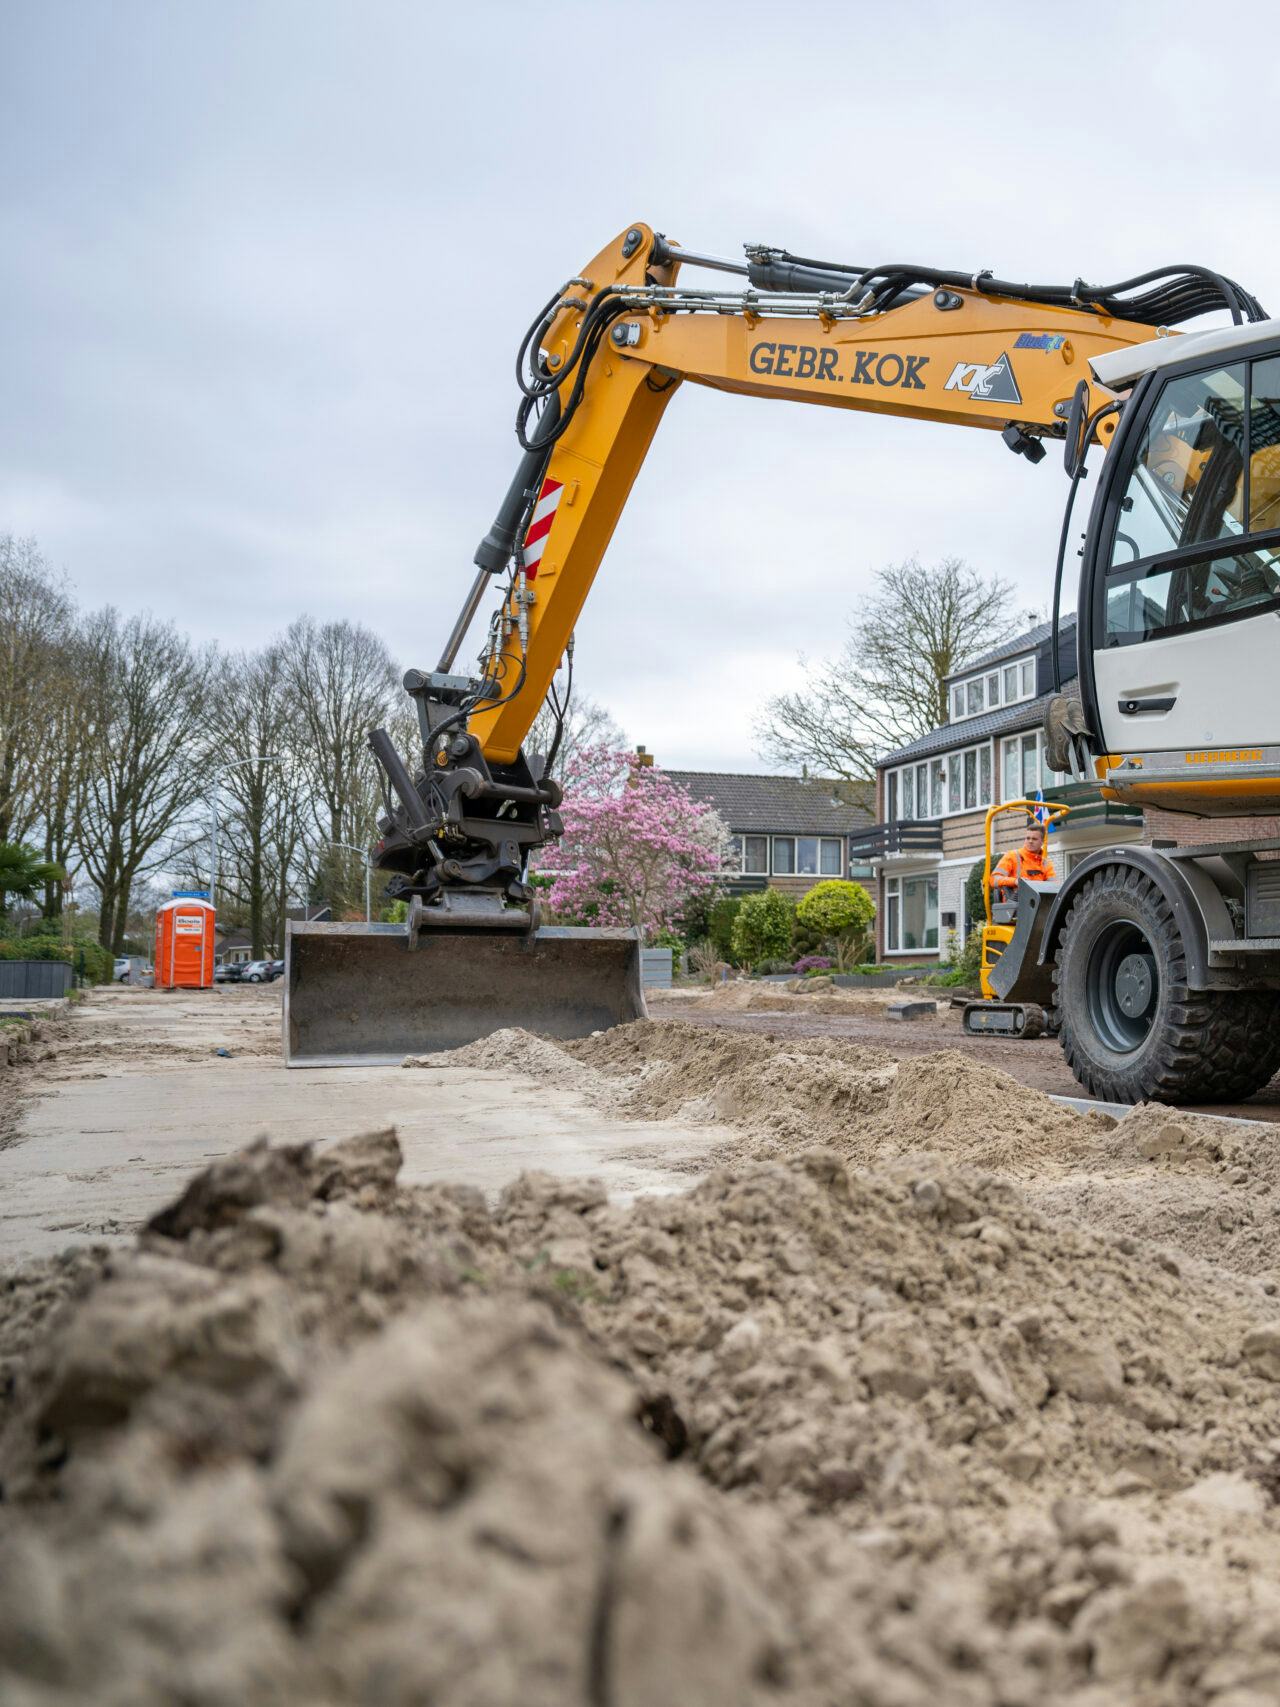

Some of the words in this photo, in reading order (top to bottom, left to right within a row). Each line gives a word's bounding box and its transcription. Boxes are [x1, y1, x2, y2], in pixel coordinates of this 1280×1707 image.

[749, 342, 844, 382] GEBR.
[850, 351, 930, 390] KOK
[1185, 749, 1264, 764] LIEBHERR
